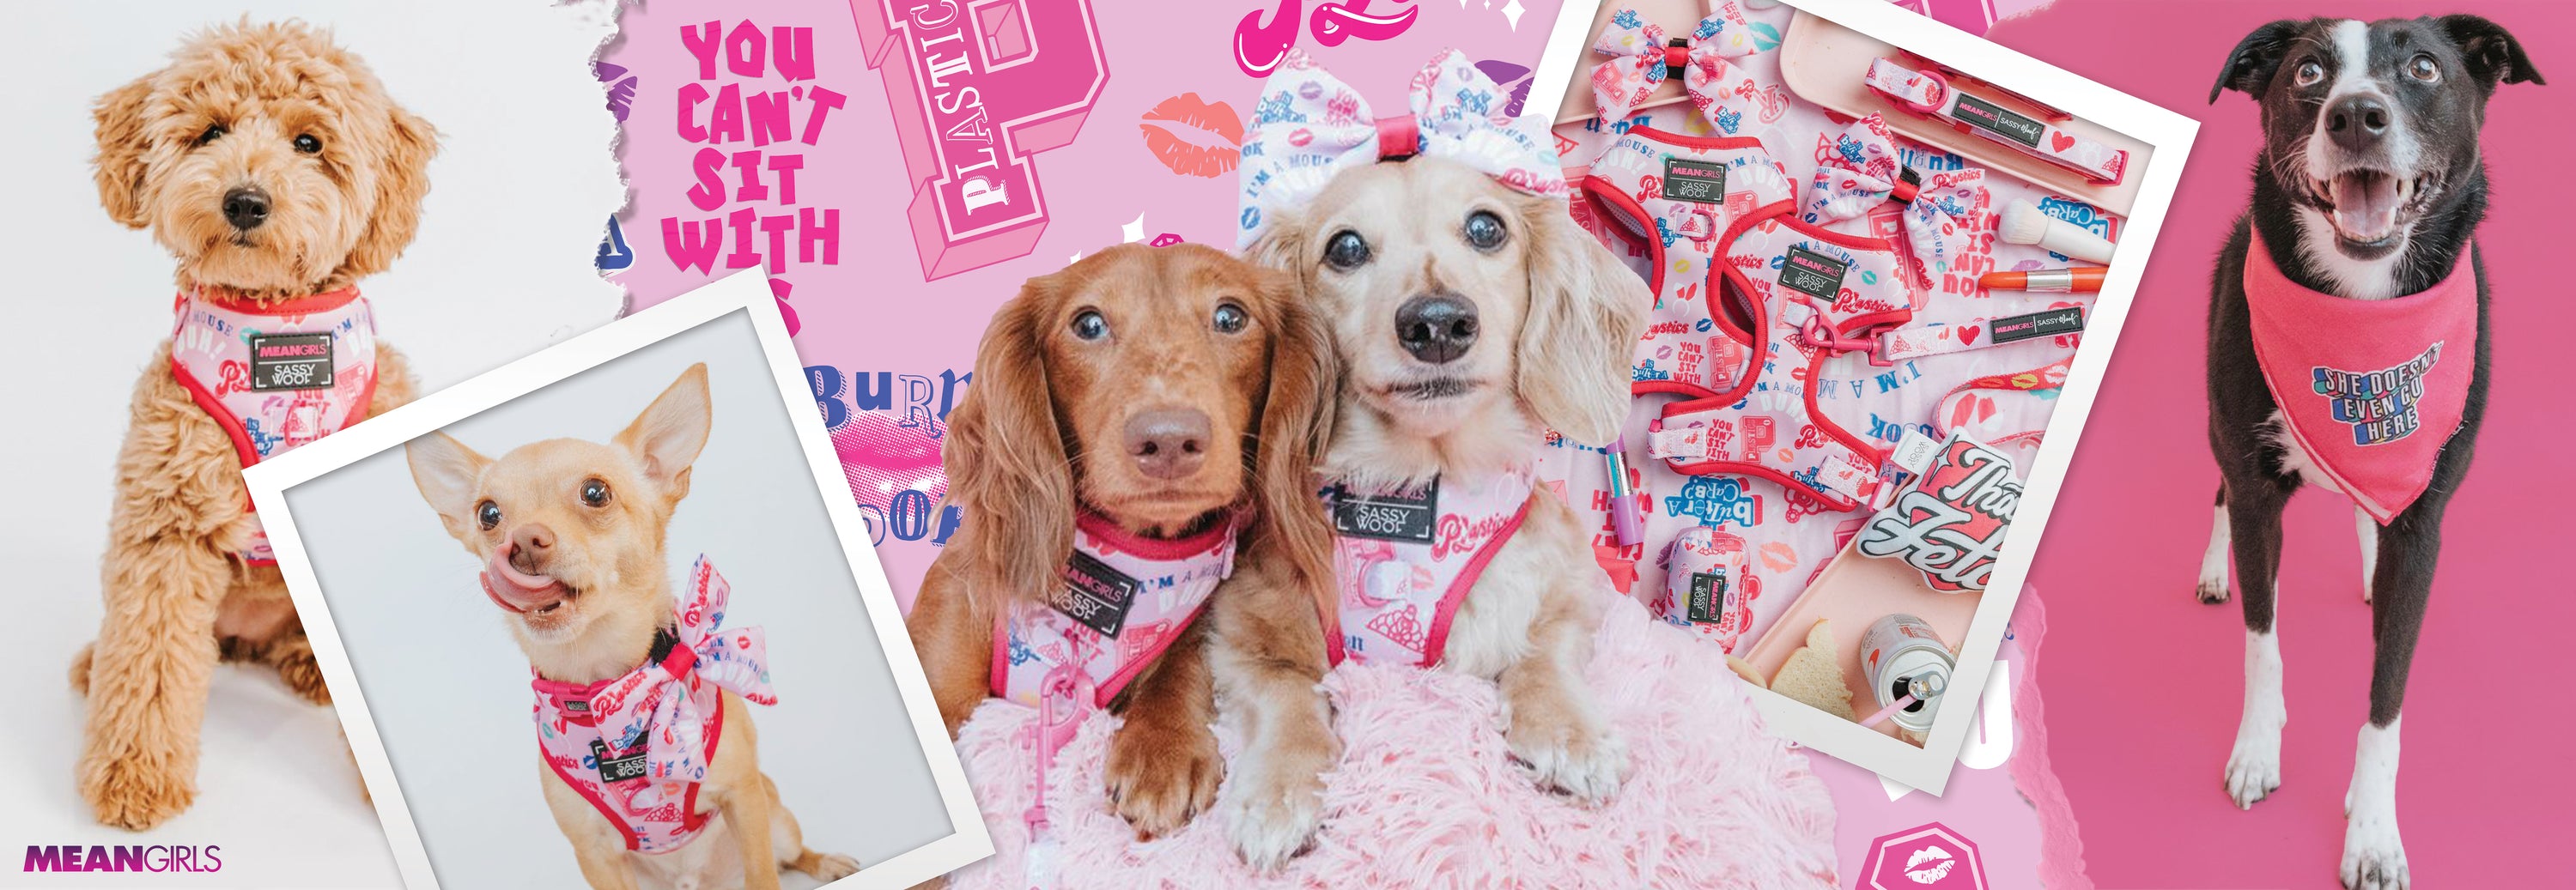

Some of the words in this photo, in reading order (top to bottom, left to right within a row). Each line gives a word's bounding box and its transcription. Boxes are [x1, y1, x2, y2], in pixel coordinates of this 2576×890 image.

[679, 18, 816, 82] YOU
[677, 82, 848, 148] CAN'T
[686, 147, 804, 212] SIT
[1680, 181, 1711, 192] SASSY
[1932, 169, 1981, 190] Plastics
[1679, 187, 1707, 198] WOOF
[660, 206, 840, 276] WITH
[1966, 233, 1996, 256] SI
[1725, 253, 1765, 270] stics
[1814, 240, 1821, 251] A
[1826, 245, 1860, 273] MOUSE
[1949, 256, 1996, 276] CAN'
[1795, 277, 1822, 293] WOOF
[1798, 271, 1826, 287] SASSY
[1639, 320, 1690, 341] astics
[1680, 342, 1702, 354] YOU
[1677, 351, 1704, 365] CAN'T
[1678, 361, 1698, 373] SIT
[272, 372, 314, 386] WOOF
[274, 364, 316, 377] SASSY
[1673, 372, 1701, 384] WITH
[1874, 360, 1922, 395] I'M
[1773, 381, 1780, 391] A
[1850, 378, 1865, 399] A
[2324, 368, 2362, 396] SHE
[2343, 392, 2396, 419] EVEN
[2401, 376, 2421, 406] GO
[1712, 418, 1733, 430] YOU
[2366, 408, 2417, 441] HERE
[1358, 506, 1411, 524] SASSY
[1667, 499, 1681, 516] A
[1356, 517, 1403, 535] WOOF
[1430, 512, 1514, 563] Plasti
[1065, 586, 1102, 618] ASSY
[616, 764, 646, 778] WOO
[617, 759, 646, 772] SASS
